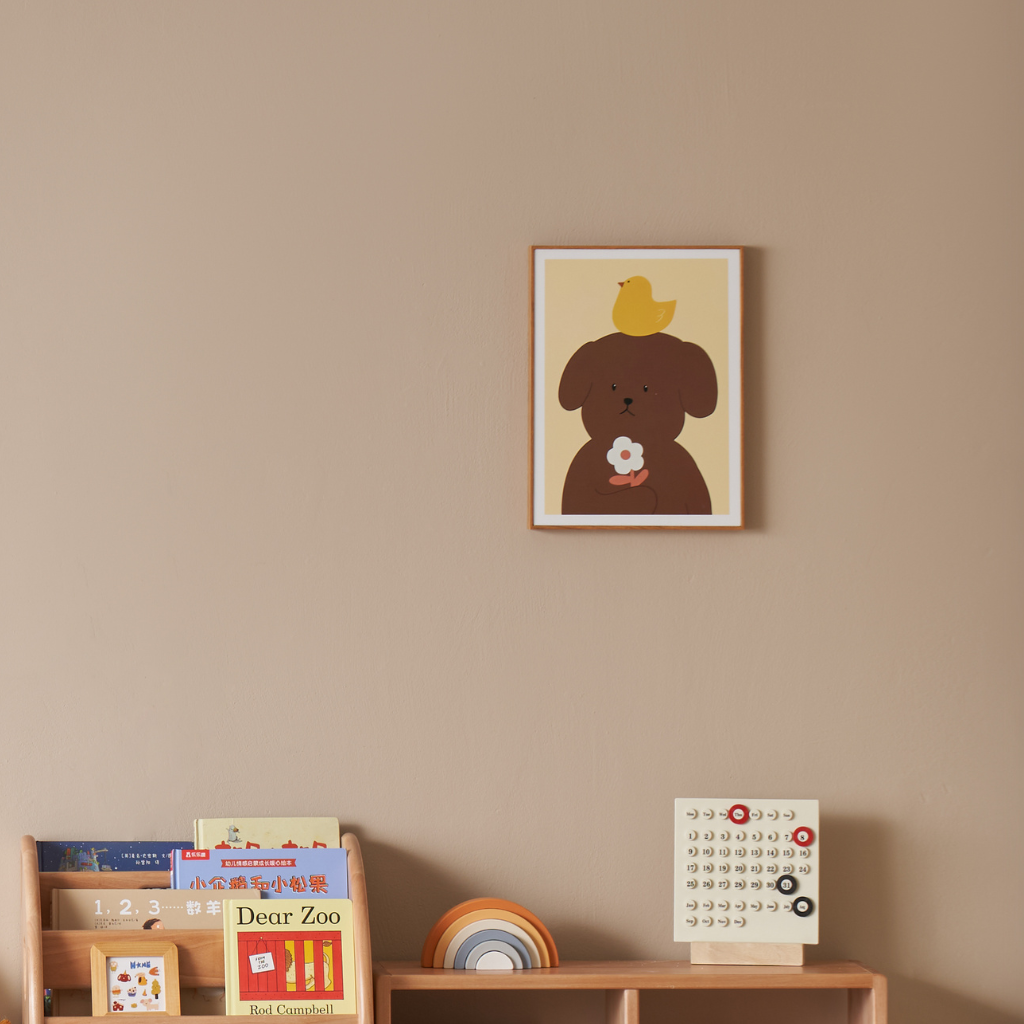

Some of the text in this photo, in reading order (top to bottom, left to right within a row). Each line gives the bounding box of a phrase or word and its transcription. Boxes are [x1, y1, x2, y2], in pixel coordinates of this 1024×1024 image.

[236, 906, 341, 926] Dear Zoo
[249, 1004, 334, 1015] Rod Campbell
